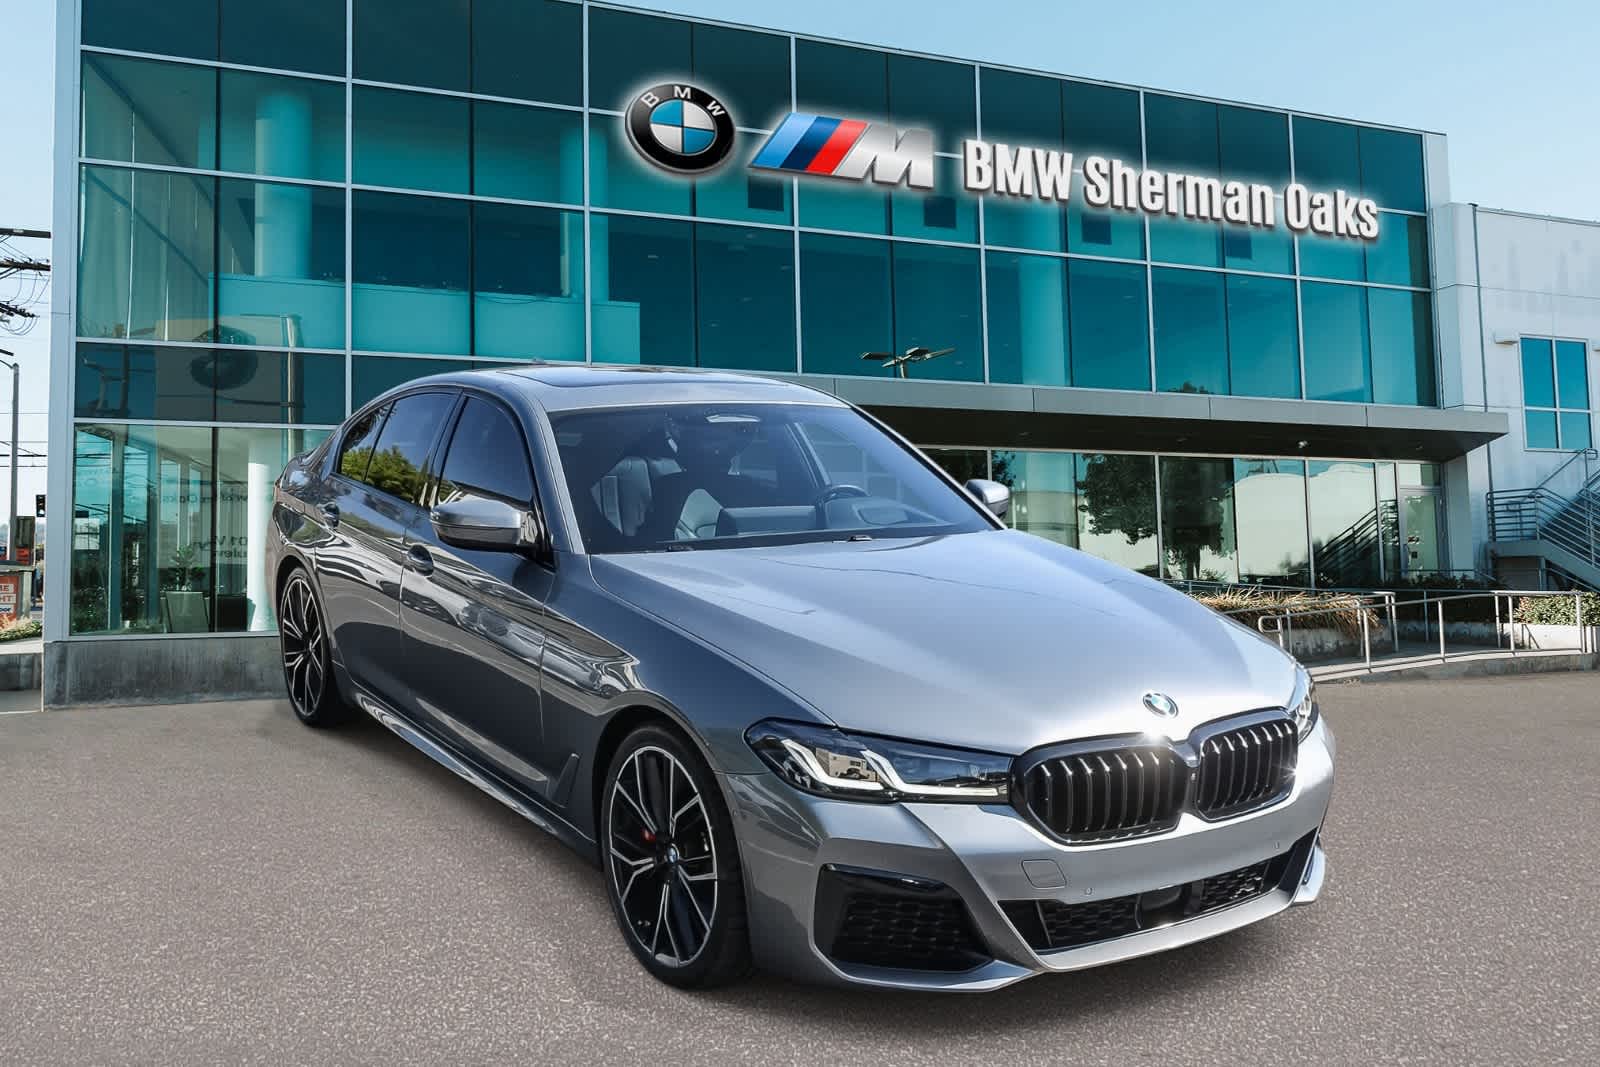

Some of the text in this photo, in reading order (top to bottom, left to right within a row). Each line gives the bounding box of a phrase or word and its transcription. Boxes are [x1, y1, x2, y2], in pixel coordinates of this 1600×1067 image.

[642, 85, 725, 117] BMW
[964, 140, 1380, 240] BMW Sherman Oaks
